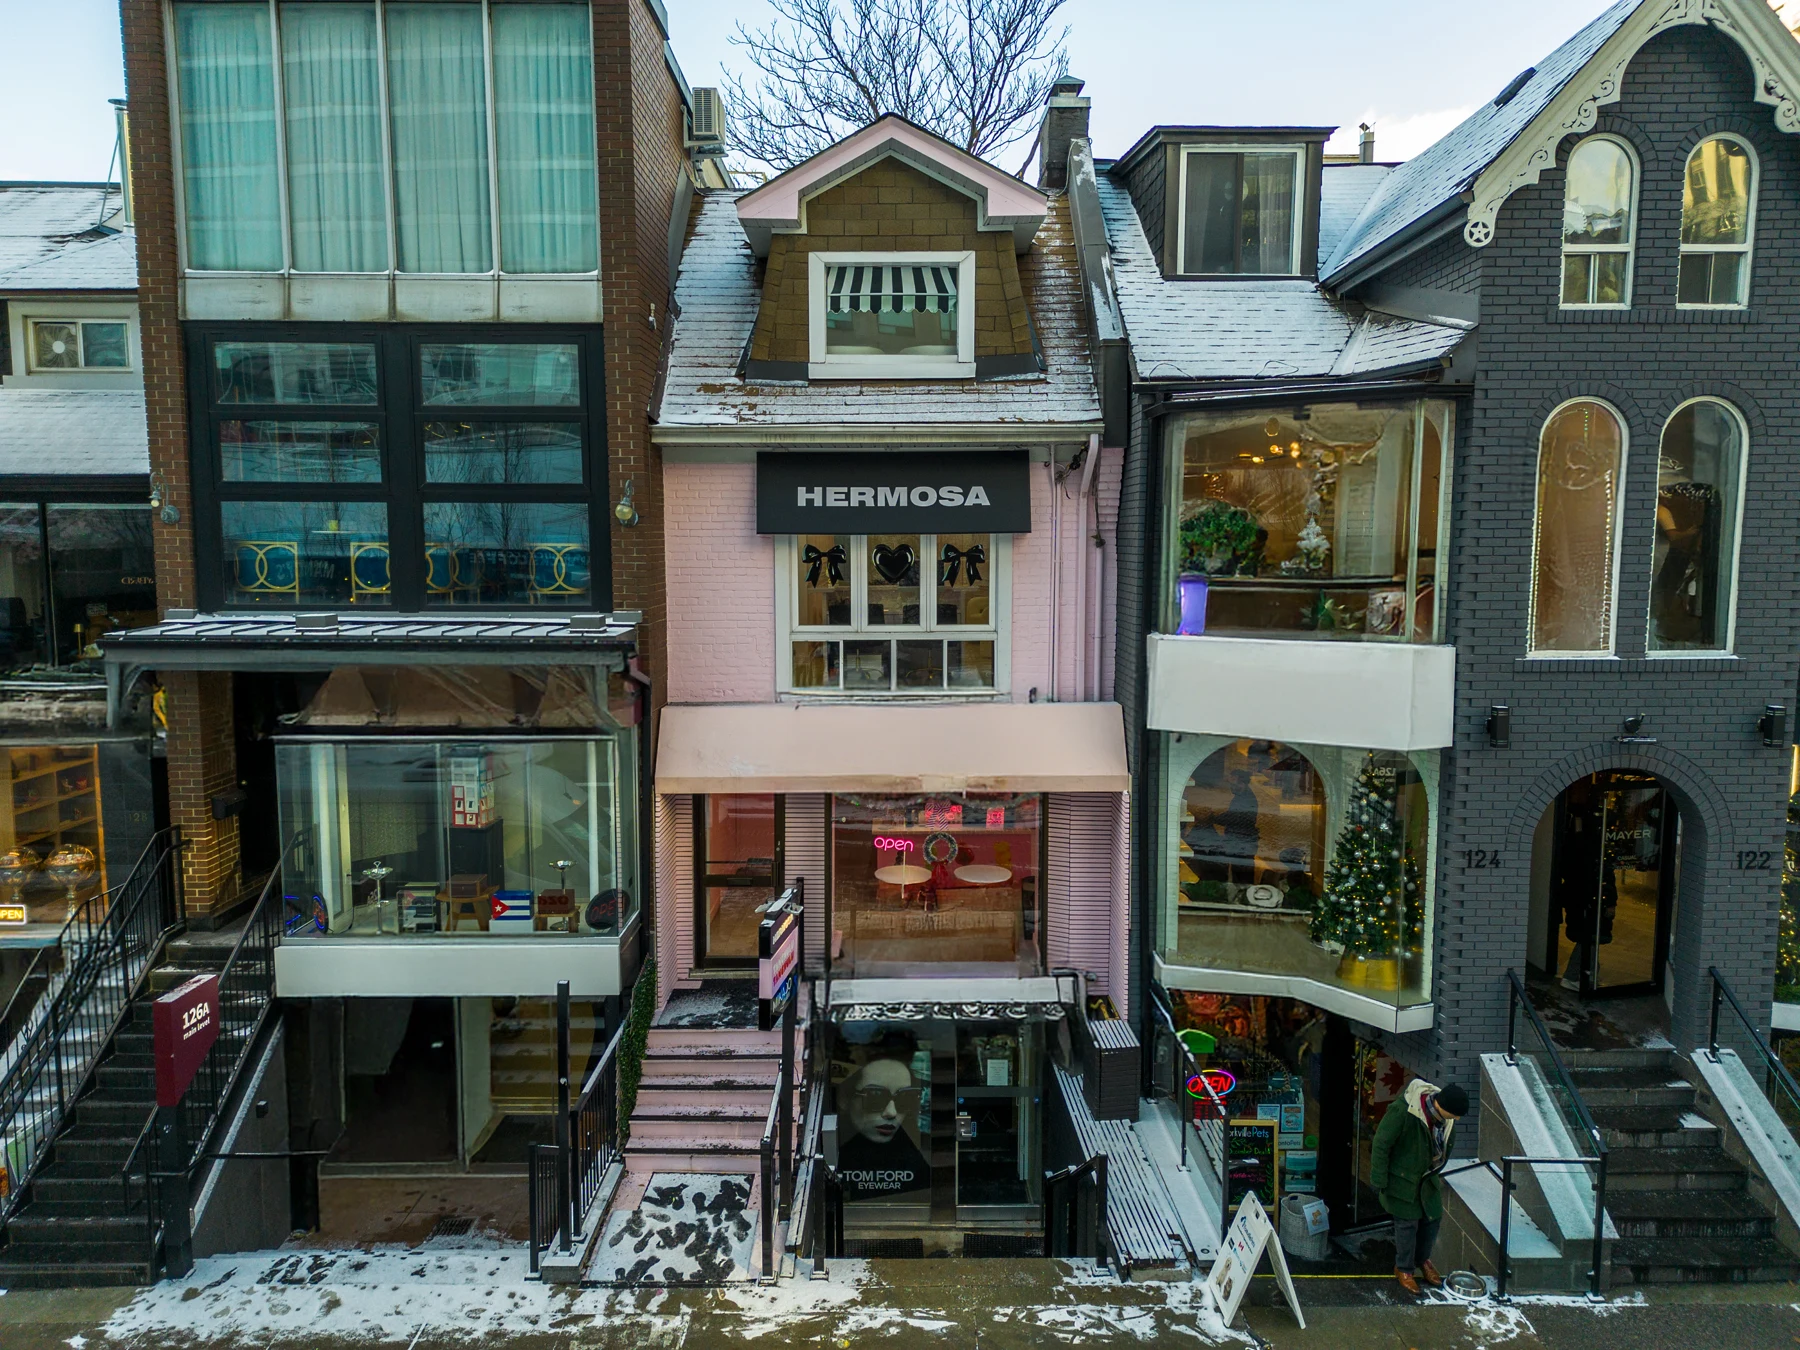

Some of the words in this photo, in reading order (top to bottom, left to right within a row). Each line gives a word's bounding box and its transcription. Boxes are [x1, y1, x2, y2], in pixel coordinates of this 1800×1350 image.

[796, 485, 991, 508] HERMOSA
[873, 835, 914, 852] open
[1605, 829, 1651, 842] MAYER
[1465, 849, 1501, 869] 124
[1736, 850, 1772, 870] 122
[0, 909, 23, 920] PEN
[590, 898, 624, 923] OPE
[183, 1003, 209, 1029] 126A
[184, 1027, 197, 1040] main
[197, 1017, 210, 1030] level
[843, 1170, 874, 1182] TOM
[876, 1170, 914, 1182] FORD
[858, 1182, 901, 1190] EYEWEAR
